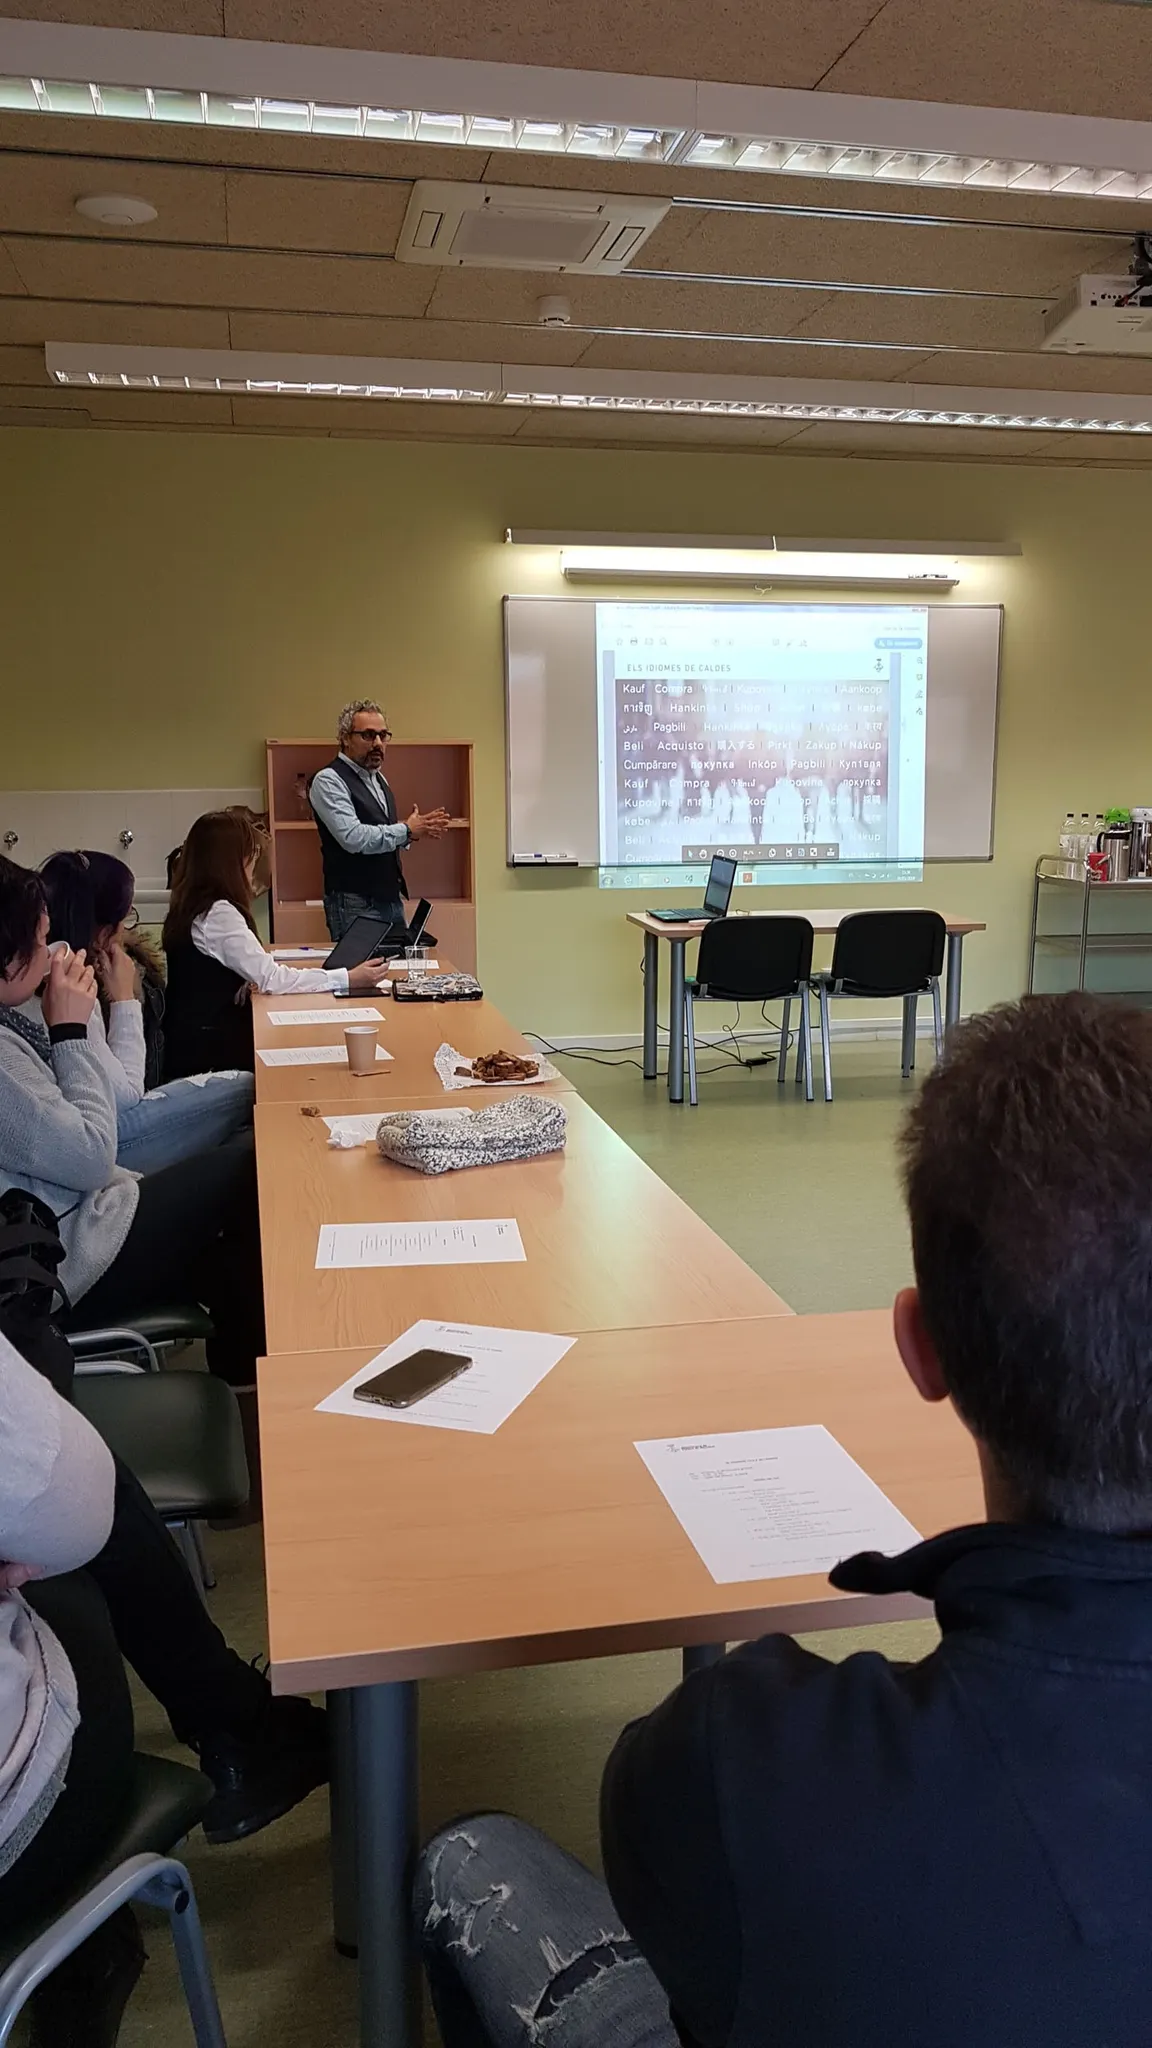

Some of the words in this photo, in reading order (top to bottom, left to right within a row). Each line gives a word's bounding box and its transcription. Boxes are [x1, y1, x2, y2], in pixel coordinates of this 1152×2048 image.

[627, 664, 643, 672] ELS
[646, 664, 681, 672] IDIOMES
[685, 664, 696, 672] DE
[699, 664, 731, 672] CALDES
[623, 683, 646, 694] Kauf
[654, 684, 693, 696] Compra
[840, 685, 882, 695] Aankoop
[653, 722, 686, 734] Pagbili
[624, 741, 644, 751] Beli
[657, 741, 704, 752] Acquisto
[806, 741, 837, 752] Zakup
[791, 759, 825, 771] Pagbili
[624, 778, 649, 789] Kauf
[669, 778, 710, 789] Cmpra
[775, 778, 823, 788] Kpovina
[624, 798, 673, 808] Kupovna
